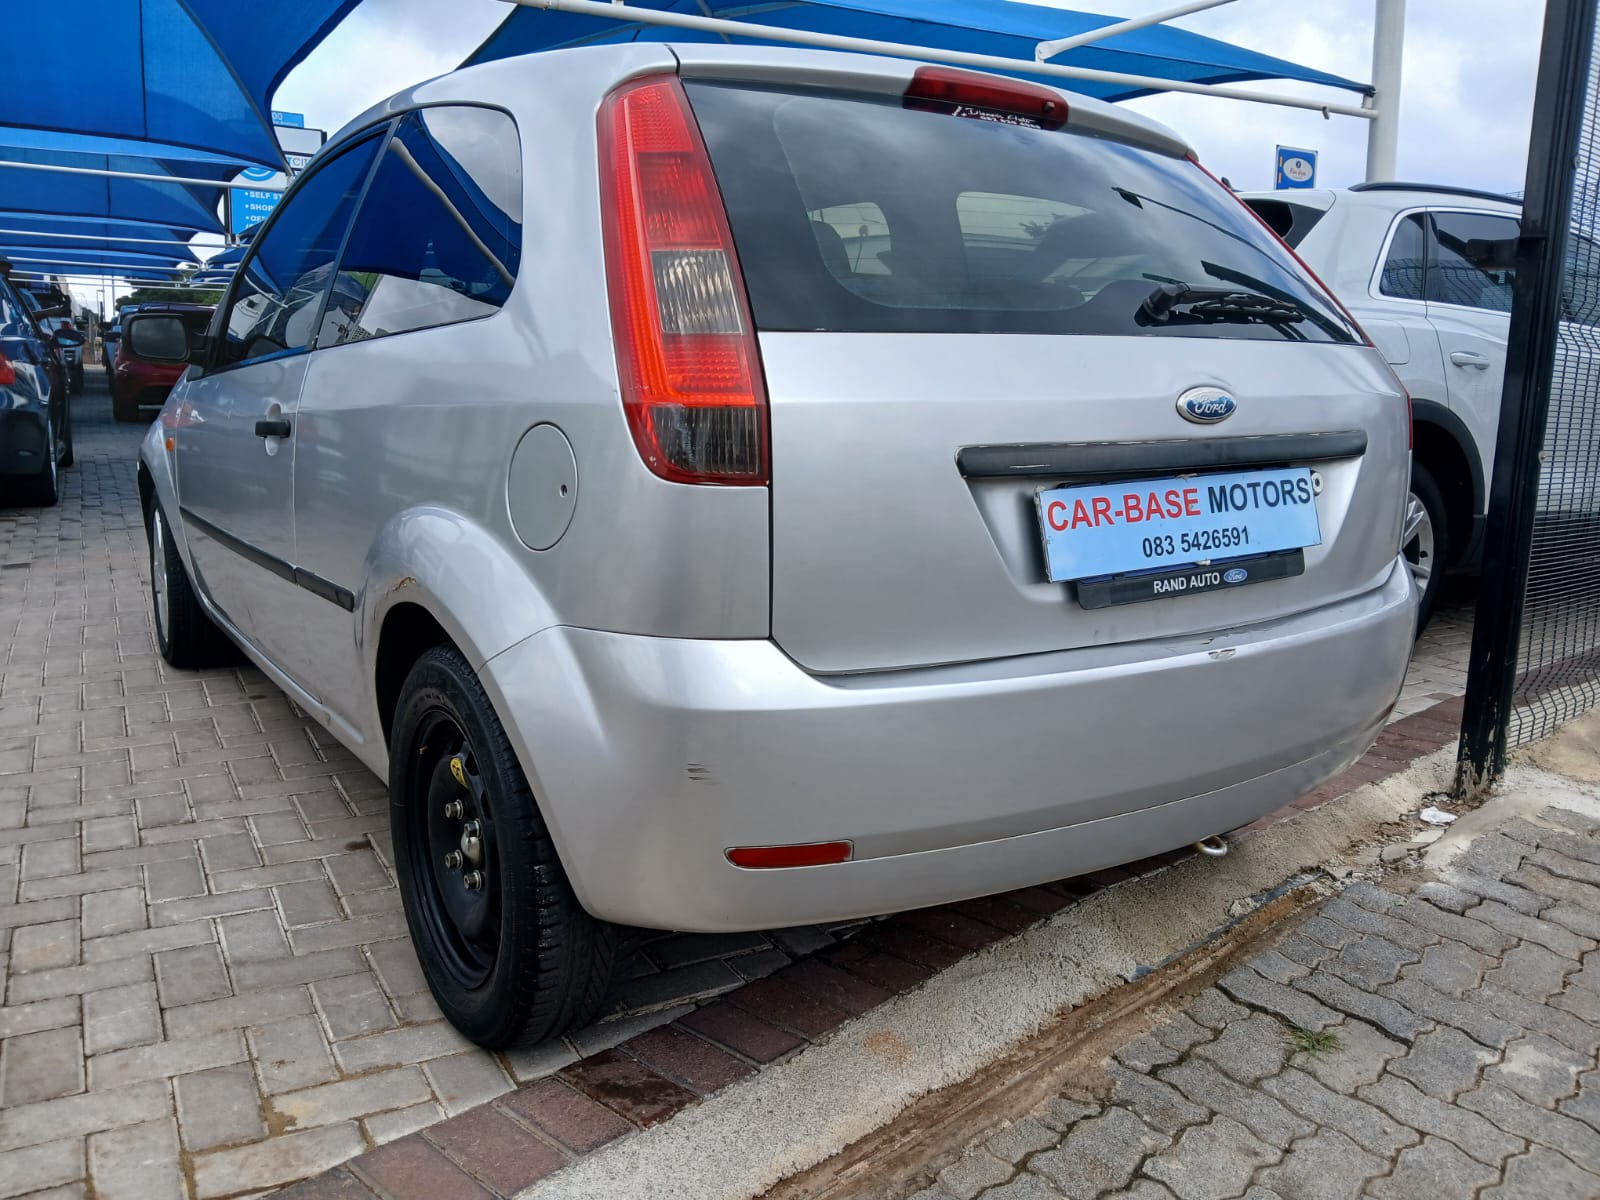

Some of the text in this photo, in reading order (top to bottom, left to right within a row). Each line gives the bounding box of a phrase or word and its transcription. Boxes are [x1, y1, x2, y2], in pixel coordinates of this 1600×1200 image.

[249, 191, 271, 200] SELF
[1048, 477, 1312, 531] CAR-BASE MOTORS
[1142, 525, 1250, 558] 083 5426591
[1153, 577, 1187, 594] RAND
[1189, 572, 1221, 589] AUTO
